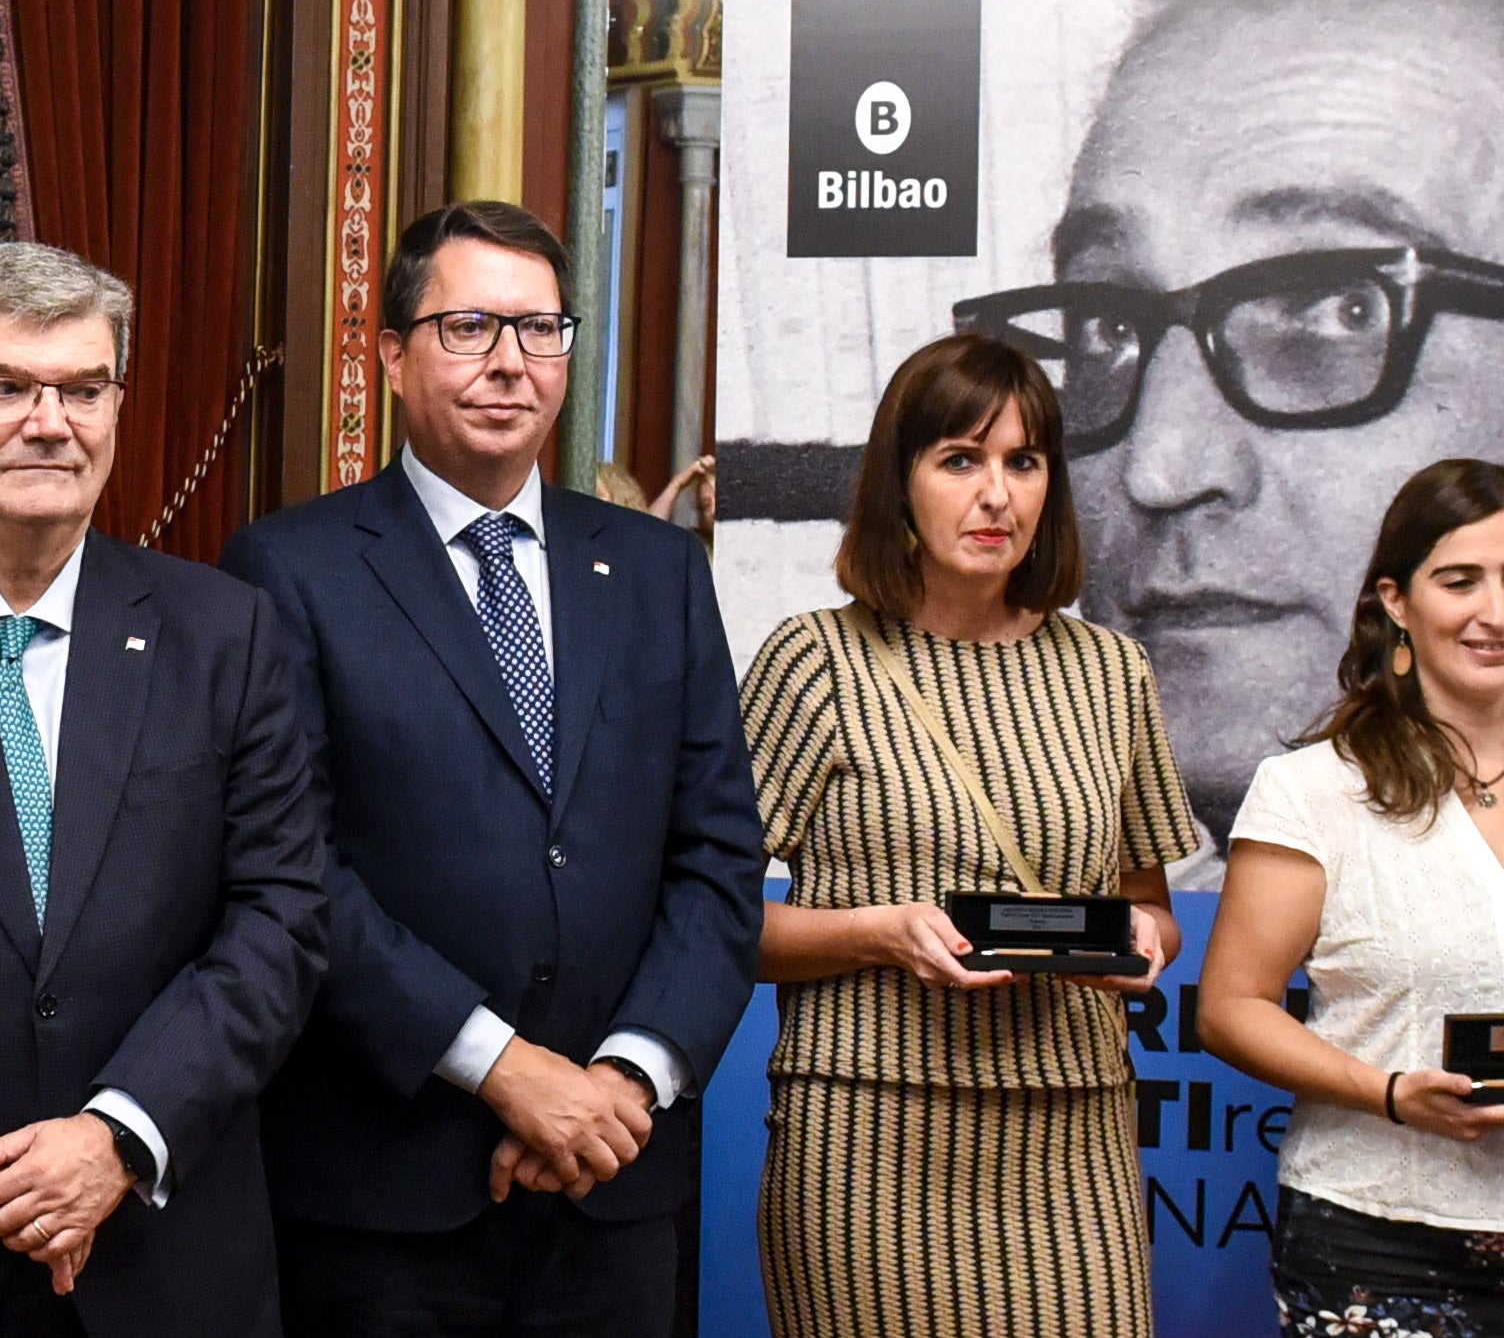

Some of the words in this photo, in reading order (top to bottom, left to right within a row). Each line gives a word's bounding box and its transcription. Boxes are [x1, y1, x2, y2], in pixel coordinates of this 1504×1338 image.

[870, 100, 900, 136] B
[818, 170, 948, 209] Bilbao
[1136, 1079, 1293, 1155] TIre
